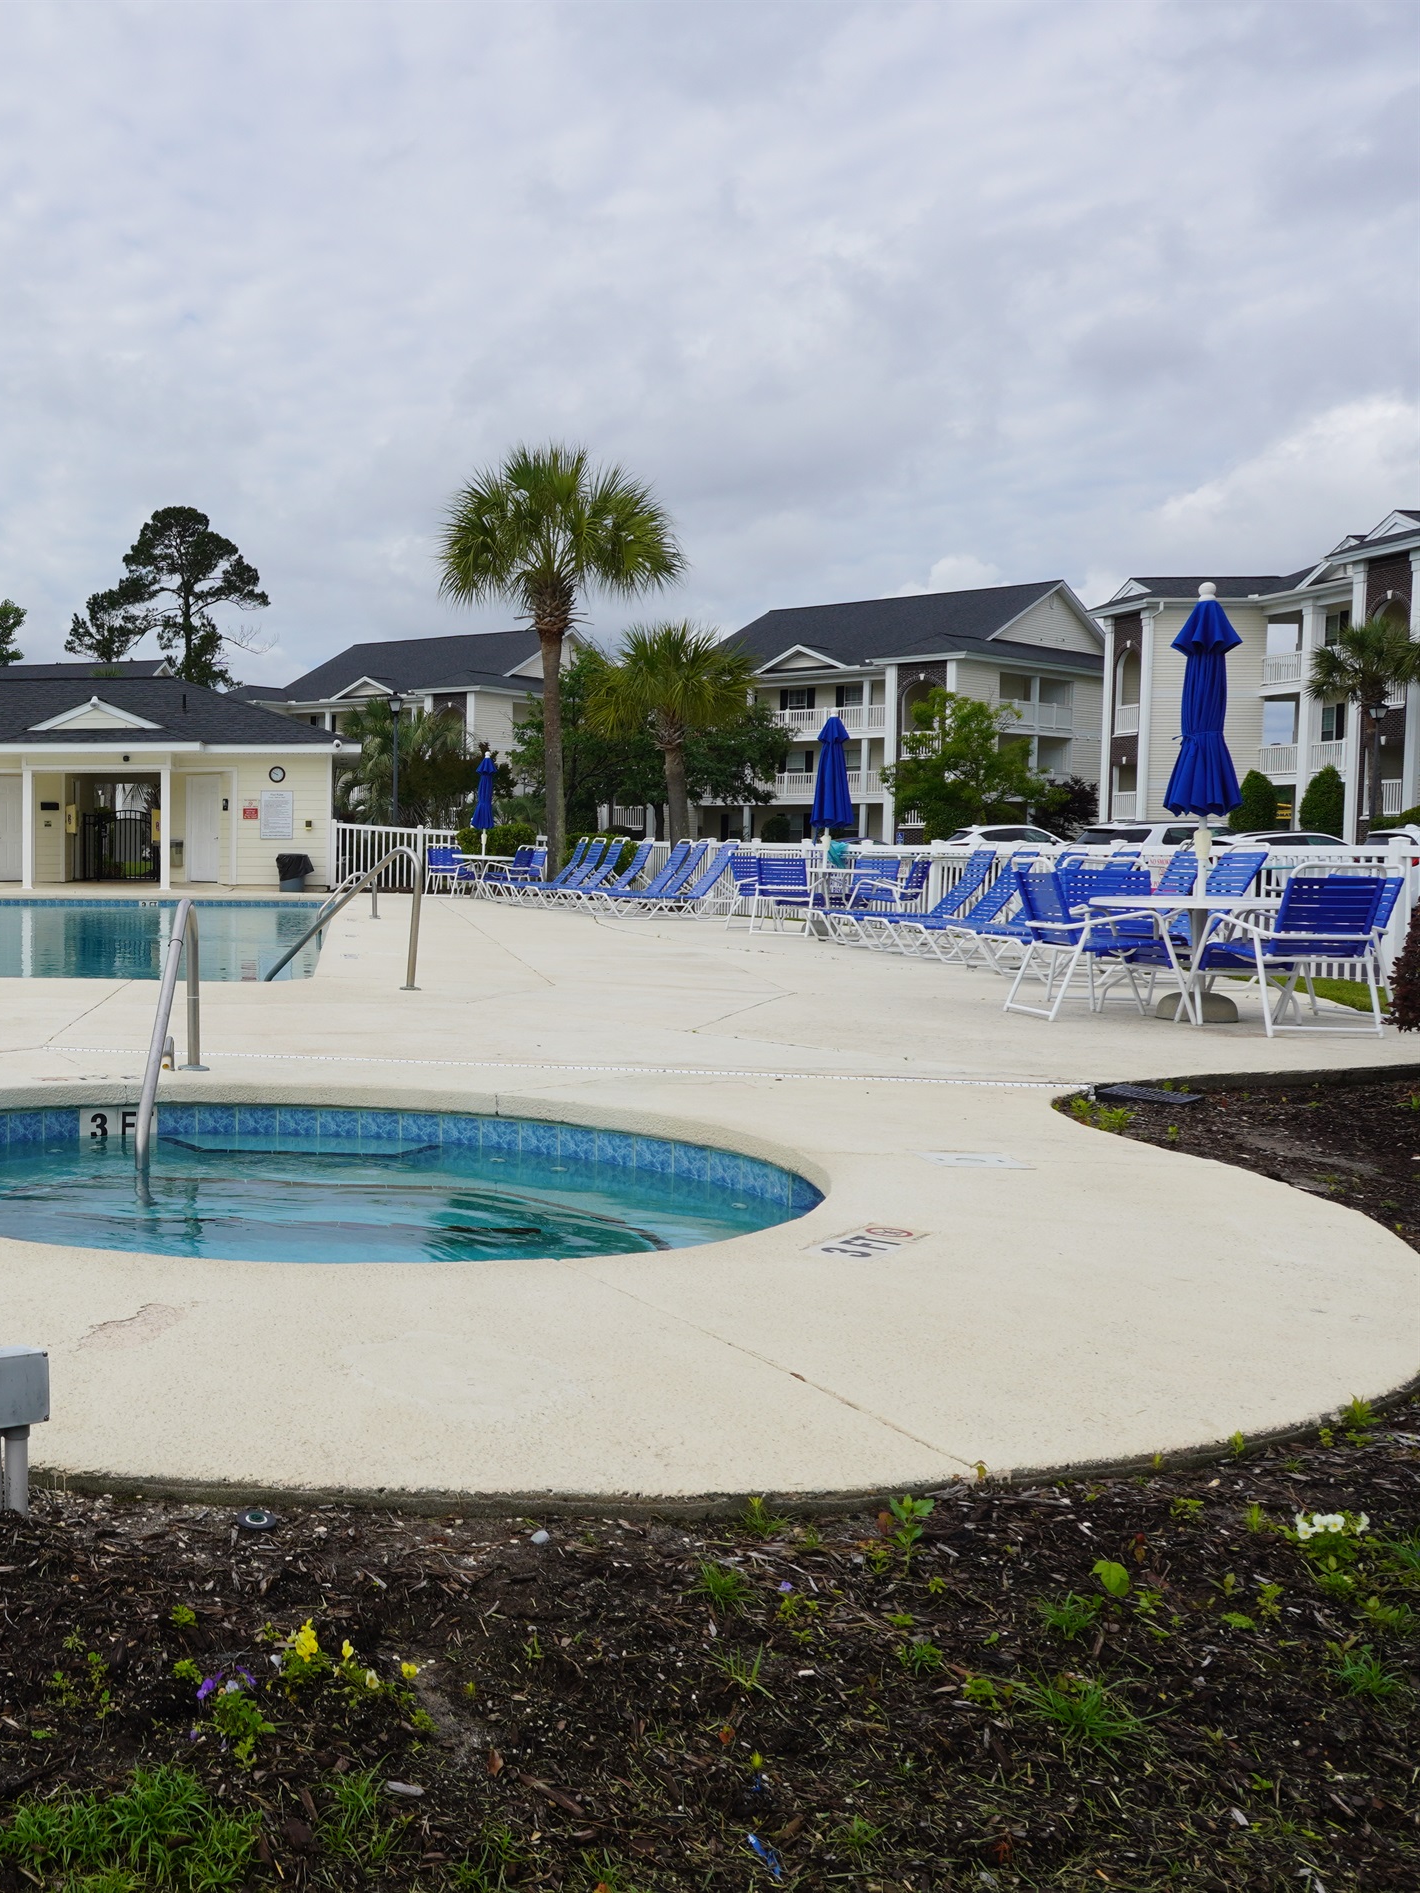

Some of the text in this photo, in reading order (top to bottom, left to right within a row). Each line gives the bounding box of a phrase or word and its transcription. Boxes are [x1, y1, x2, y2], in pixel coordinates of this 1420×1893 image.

[90, 1113, 108, 1137] 3
[838, 1235, 902, 1251] FT
[820, 1247, 872, 1258] 3
